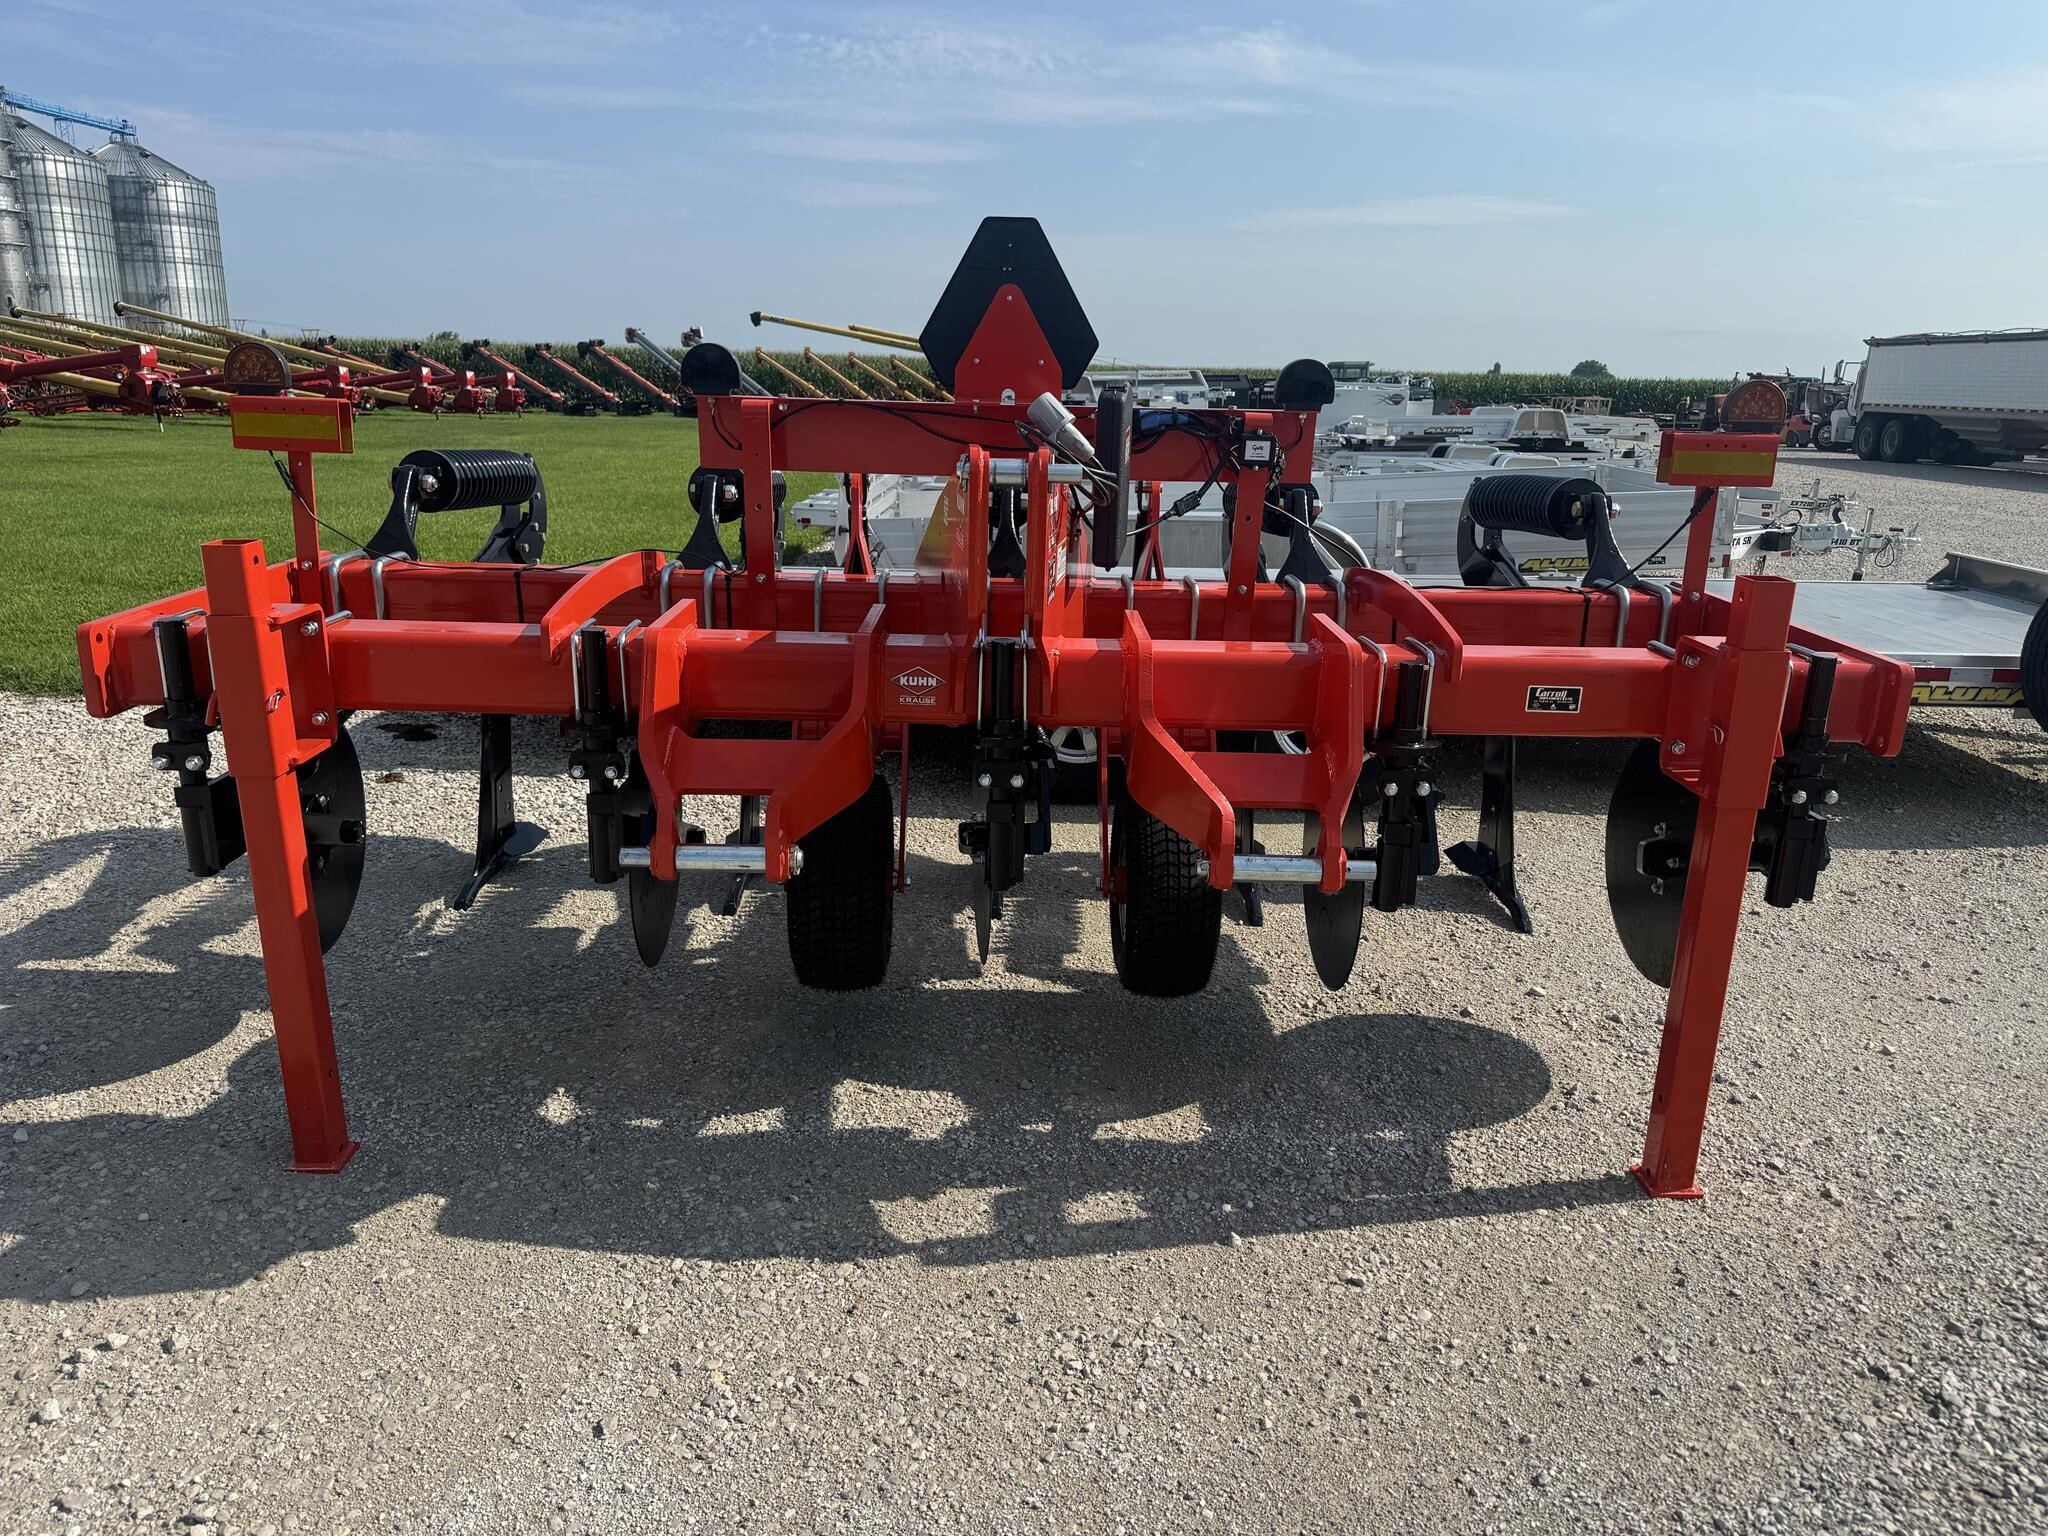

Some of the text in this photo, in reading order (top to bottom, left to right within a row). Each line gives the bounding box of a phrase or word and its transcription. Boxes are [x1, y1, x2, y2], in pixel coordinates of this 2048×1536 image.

[1742, 536, 1752, 545] SR
[1520, 557, 1589, 571] ALUM
[899, 676, 937, 687] KUHN
[1535, 687, 1568, 700] Carroll
